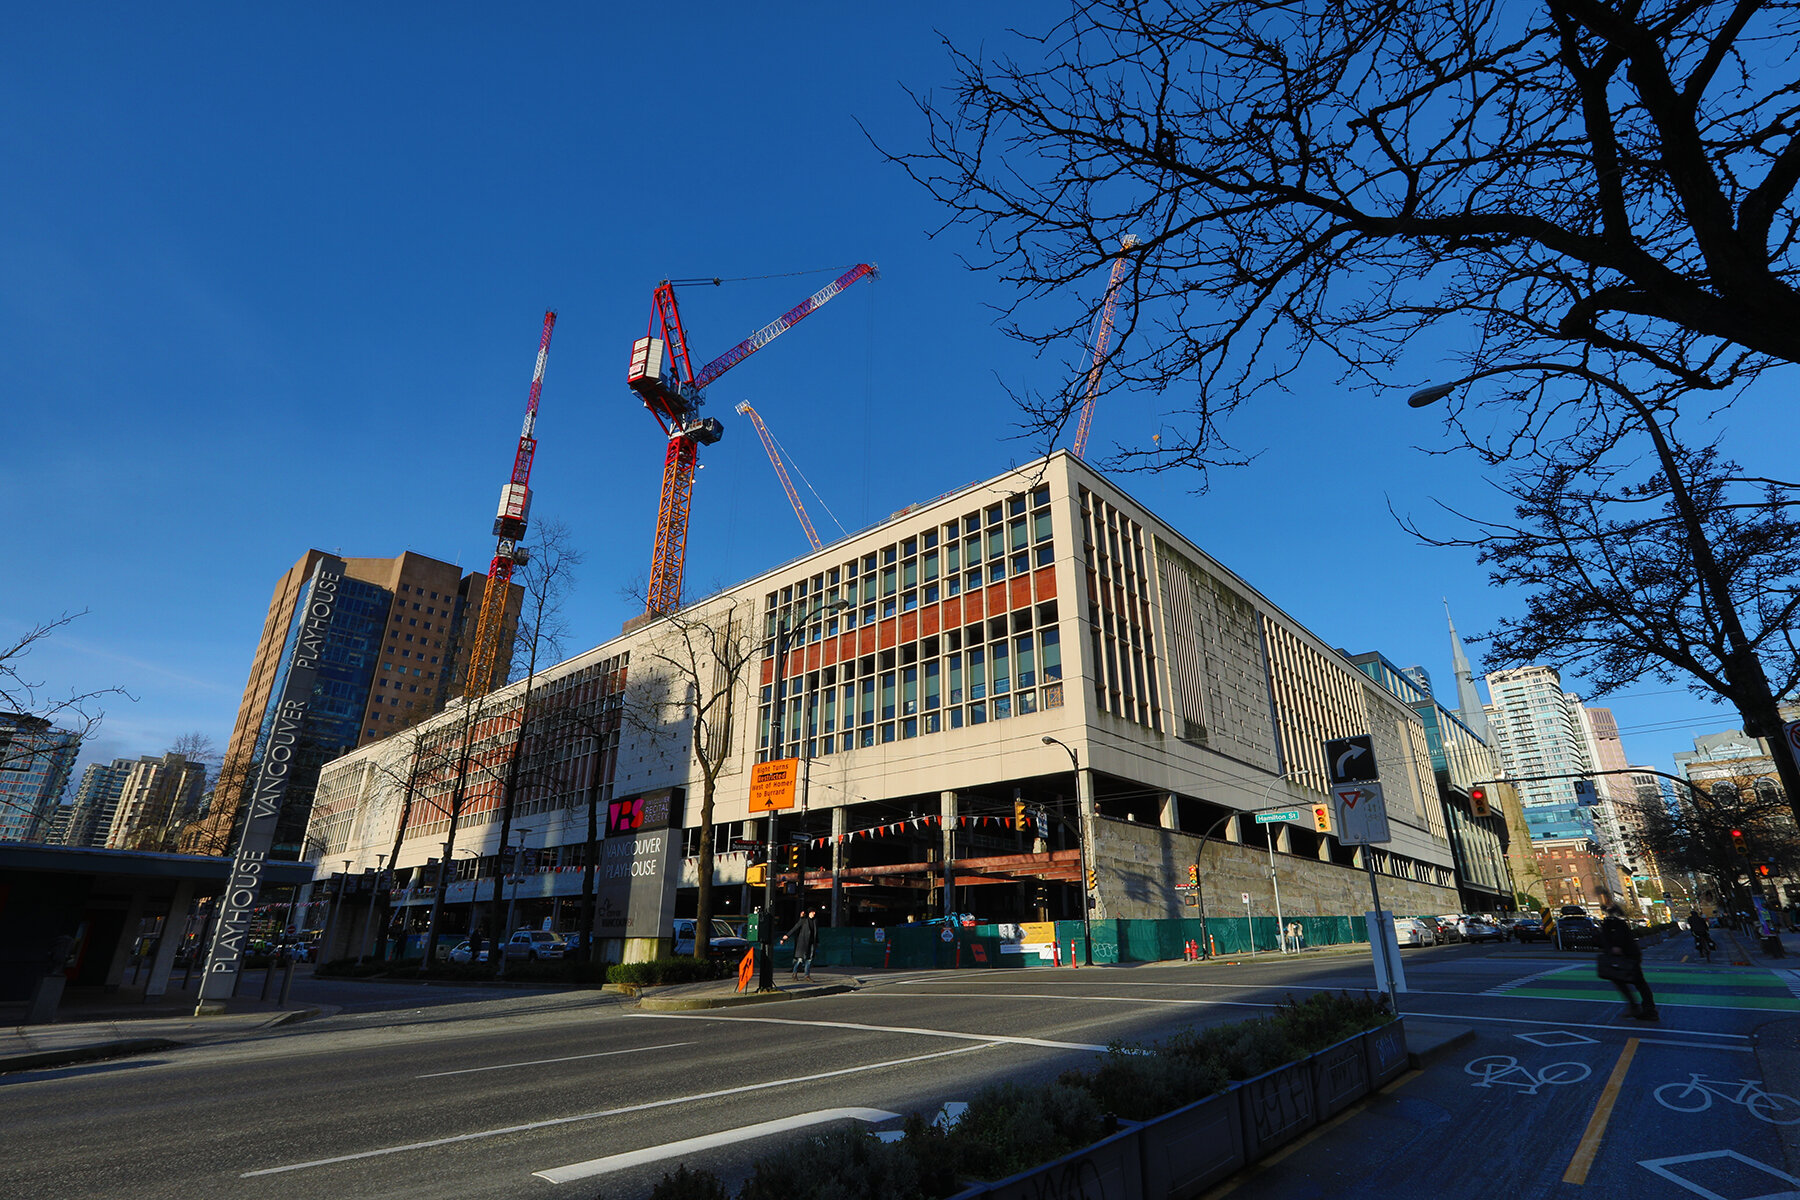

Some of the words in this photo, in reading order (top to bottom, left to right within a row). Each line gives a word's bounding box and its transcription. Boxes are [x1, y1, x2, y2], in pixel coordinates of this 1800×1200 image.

[213, 851, 264, 973] PLAYHOUSE
[255, 700, 305, 818] VANCOUVER
[297, 571, 340, 670] PLAYHOUSE
[757, 766, 771, 775] Right
[764, 789, 786, 797] Burrard
[645, 803, 669, 815] RECITAL
[644, 812, 669, 824] SOCIETY
[1258, 814, 1287, 822] Hamilton
[1288, 812, 1296, 820] St
[607, 837, 661, 858] VANCOUVER
[606, 859, 657, 879] PLAYHOUSE
